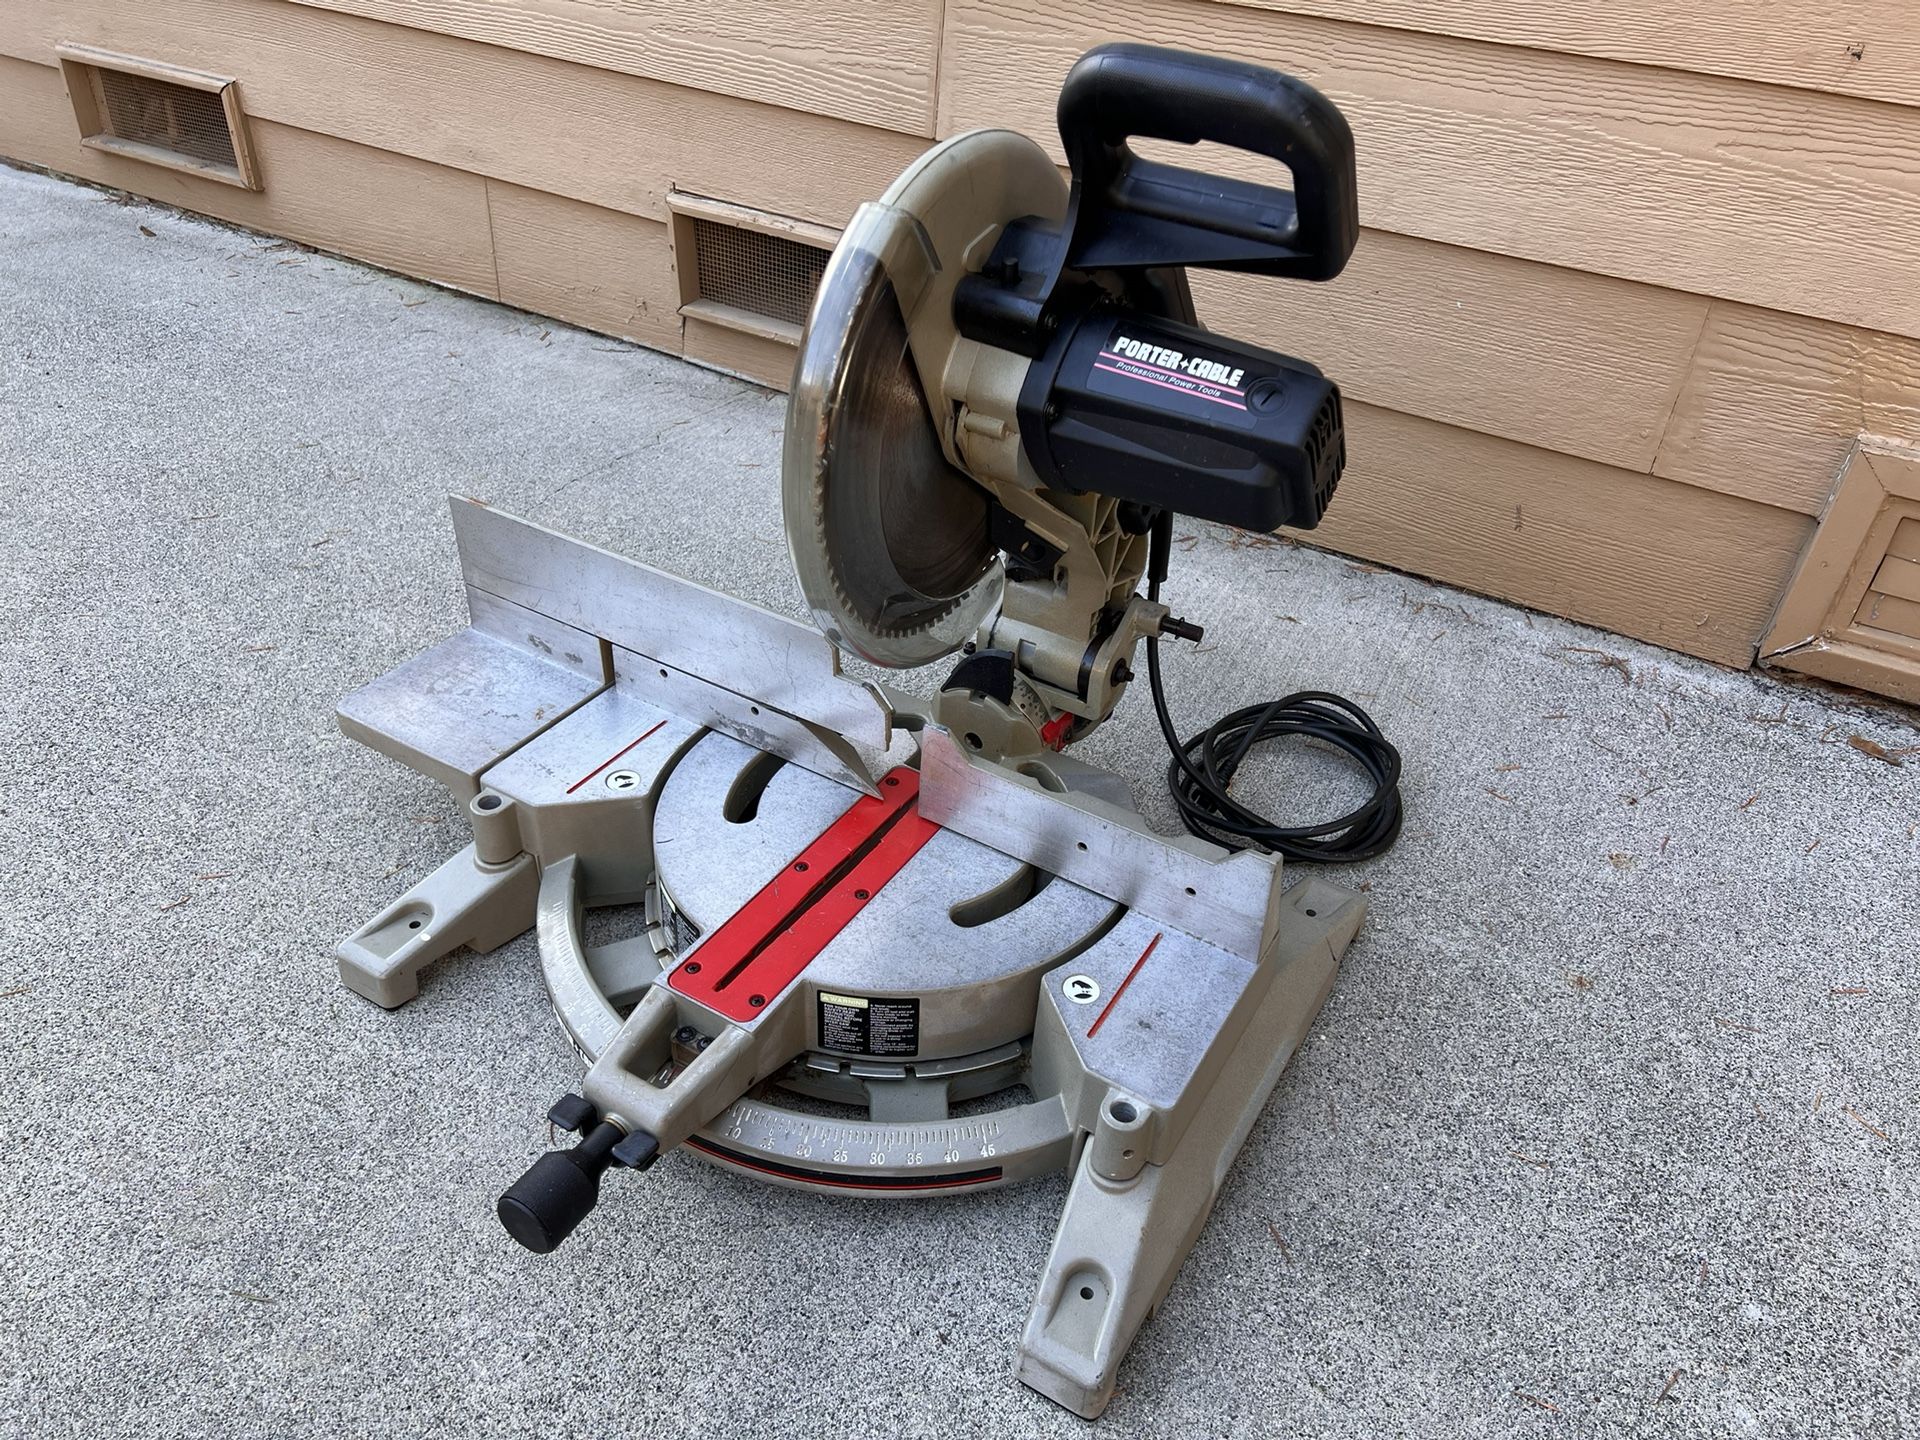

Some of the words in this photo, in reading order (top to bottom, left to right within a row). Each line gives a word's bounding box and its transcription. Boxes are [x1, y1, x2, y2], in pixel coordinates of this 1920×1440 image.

[1112, 336, 1184, 370] PORTER
[1186, 357, 1245, 388] CABLE
[1116, 361, 1168, 382] Professional
[1168, 376, 1196, 390] Power
[1198, 384, 1222, 397] Tools
[829, 995, 867, 1007] WARNING
[796, 1143, 812, 1157] 20
[833, 1149, 848, 1163] 25
[869, 1152, 885, 1165] 30
[907, 1152, 923, 1165] 35
[944, 1150, 960, 1163] 40
[980, 1143, 996, 1158] 45
